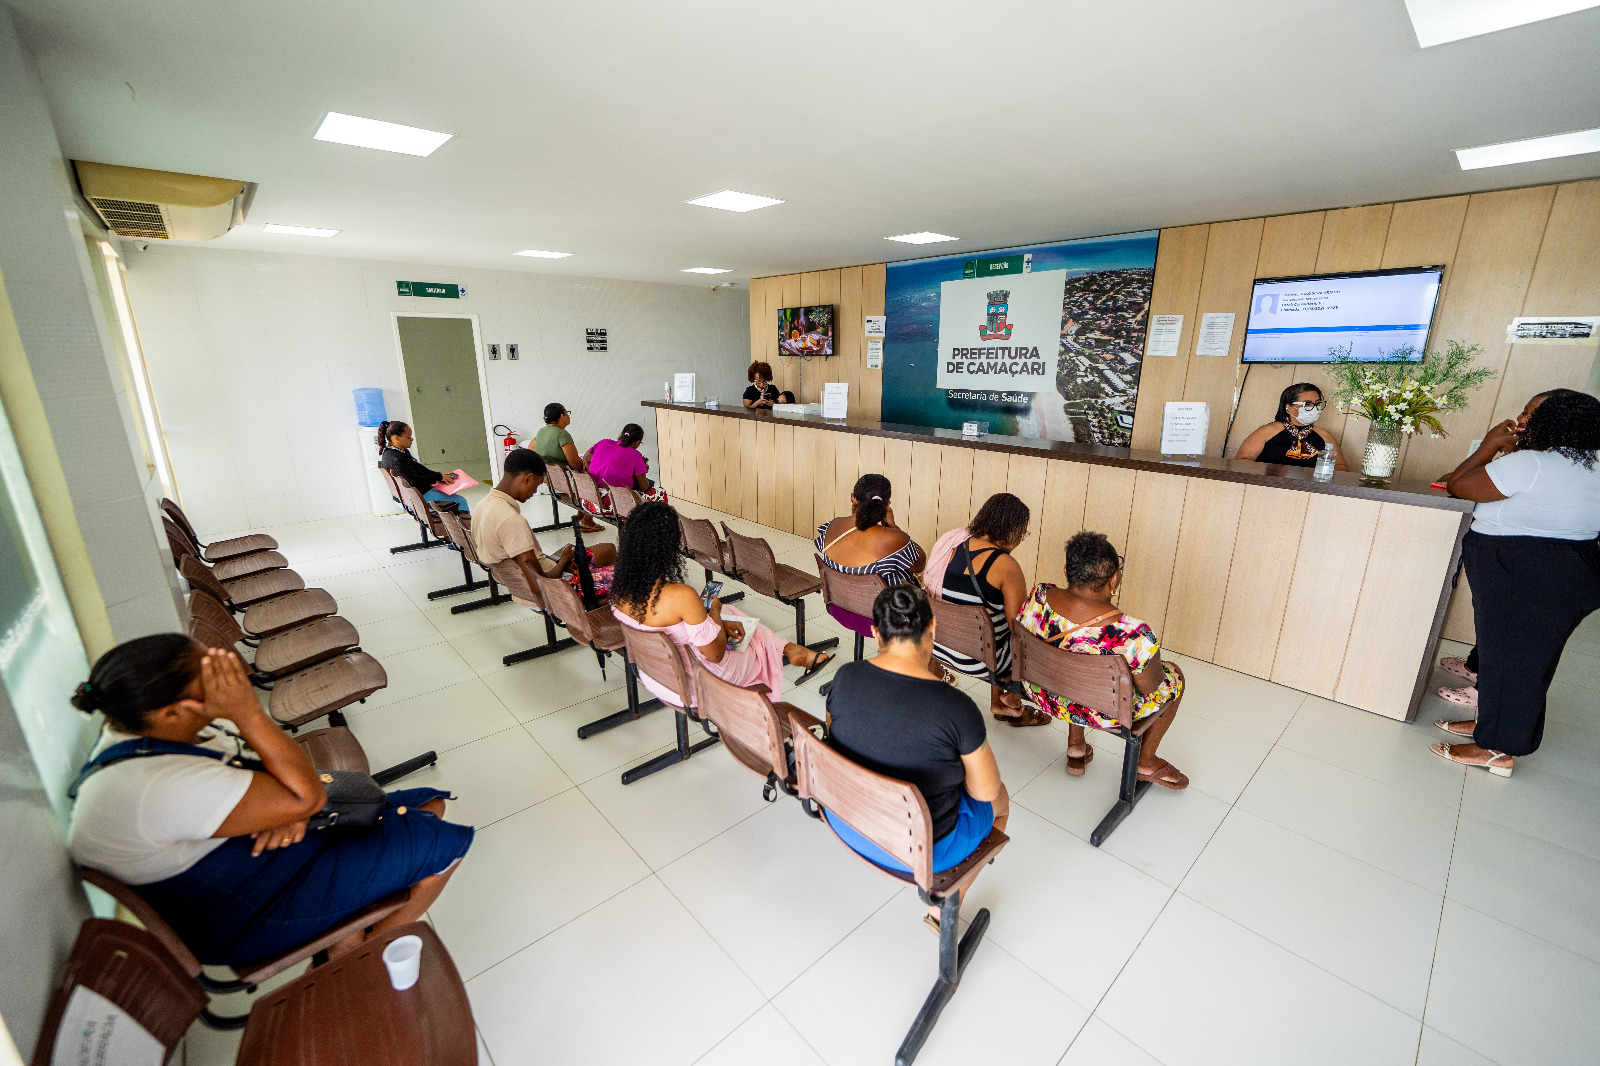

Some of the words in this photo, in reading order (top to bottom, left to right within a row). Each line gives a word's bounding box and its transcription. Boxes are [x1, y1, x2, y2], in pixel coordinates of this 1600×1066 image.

[952, 346, 1040, 360] PREFEITURA
[946, 361, 964, 374] DE
[966, 361, 1046, 377] CAMAÇARI
[948, 389, 987, 401] Secretaria
[989, 393, 999, 401] de
[1001, 392, 1028, 404] Saúde
